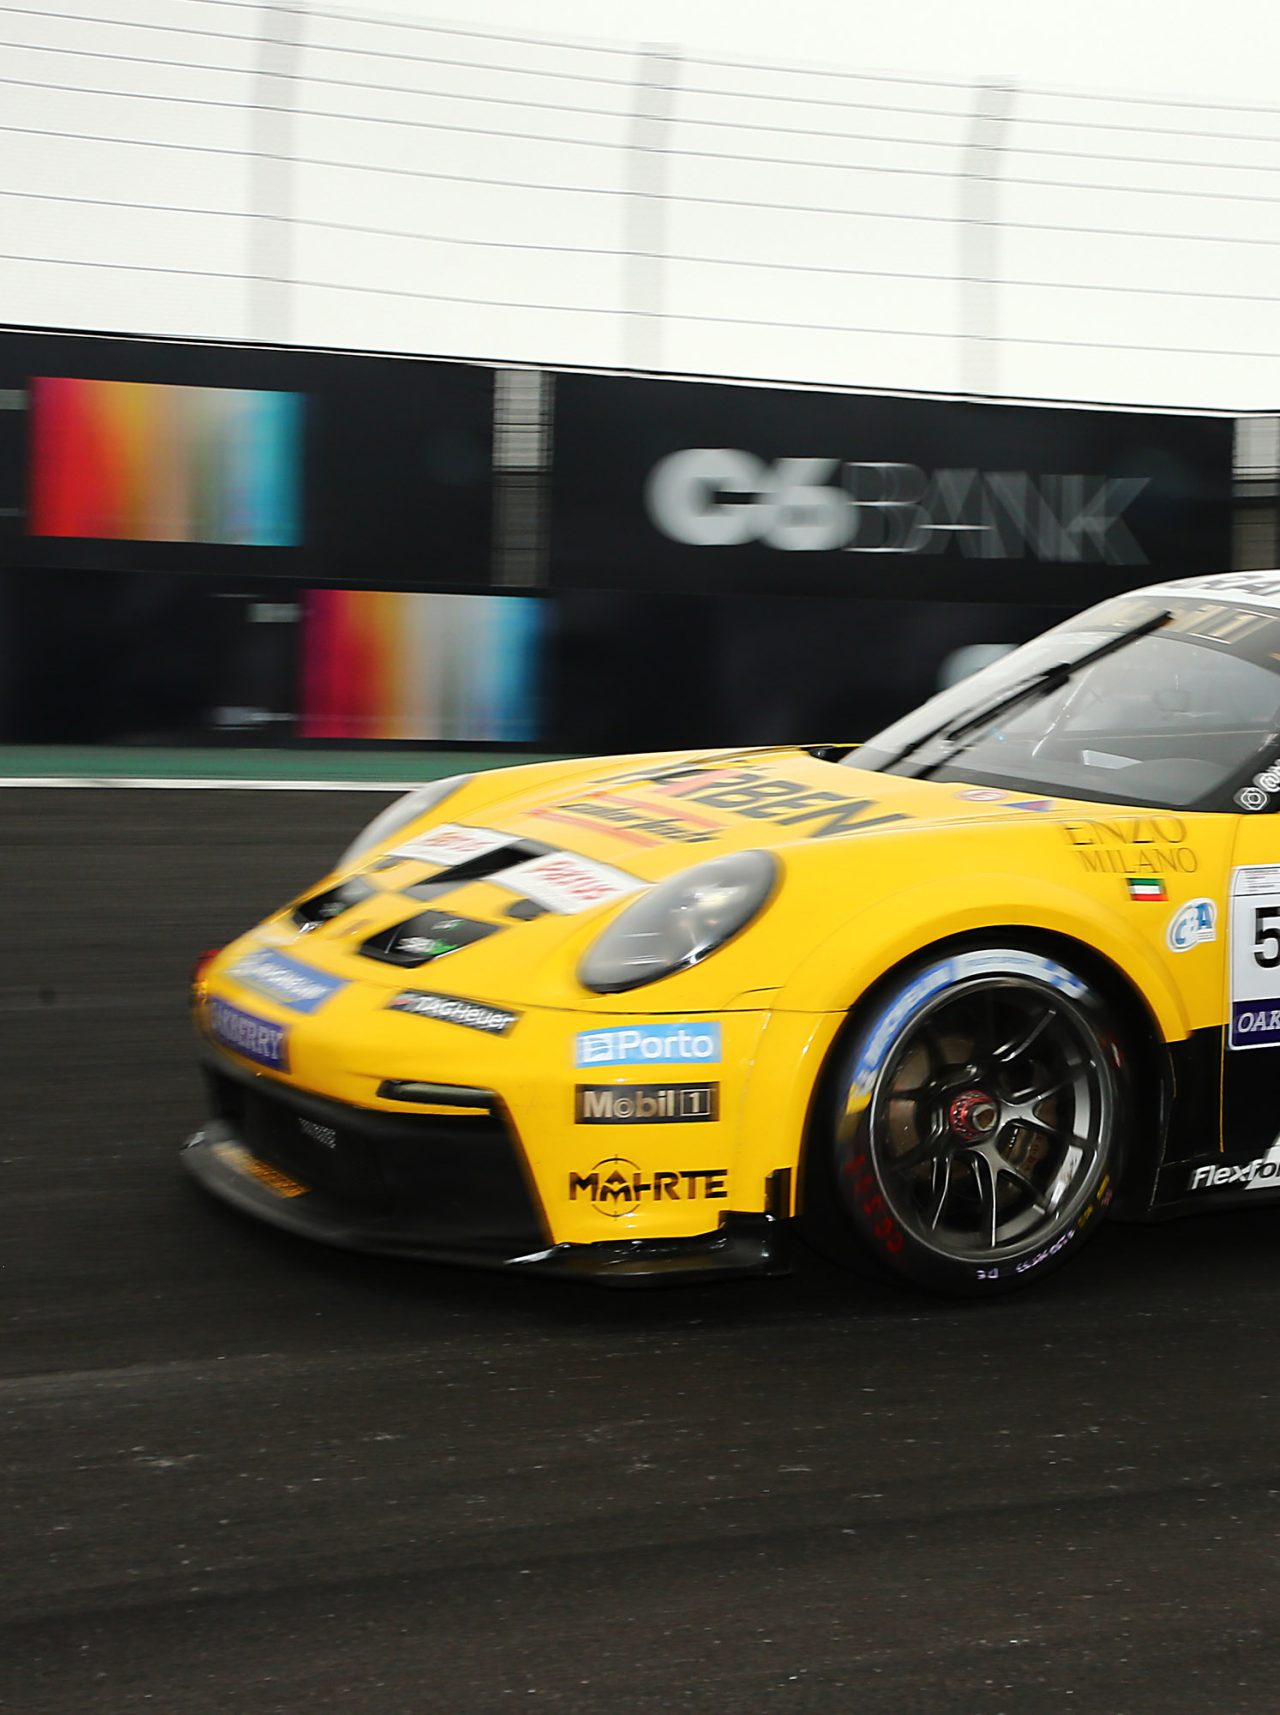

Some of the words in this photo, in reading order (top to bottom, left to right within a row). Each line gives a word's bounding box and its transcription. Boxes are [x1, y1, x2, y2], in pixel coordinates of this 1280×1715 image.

[842, 461, 1152, 565] BANK
[1056, 814, 1187, 846] ENZO
[1070, 847, 1198, 874] MILANO
[616, 1030, 715, 1060] Porto
[583, 1090, 675, 1118] Mobil
